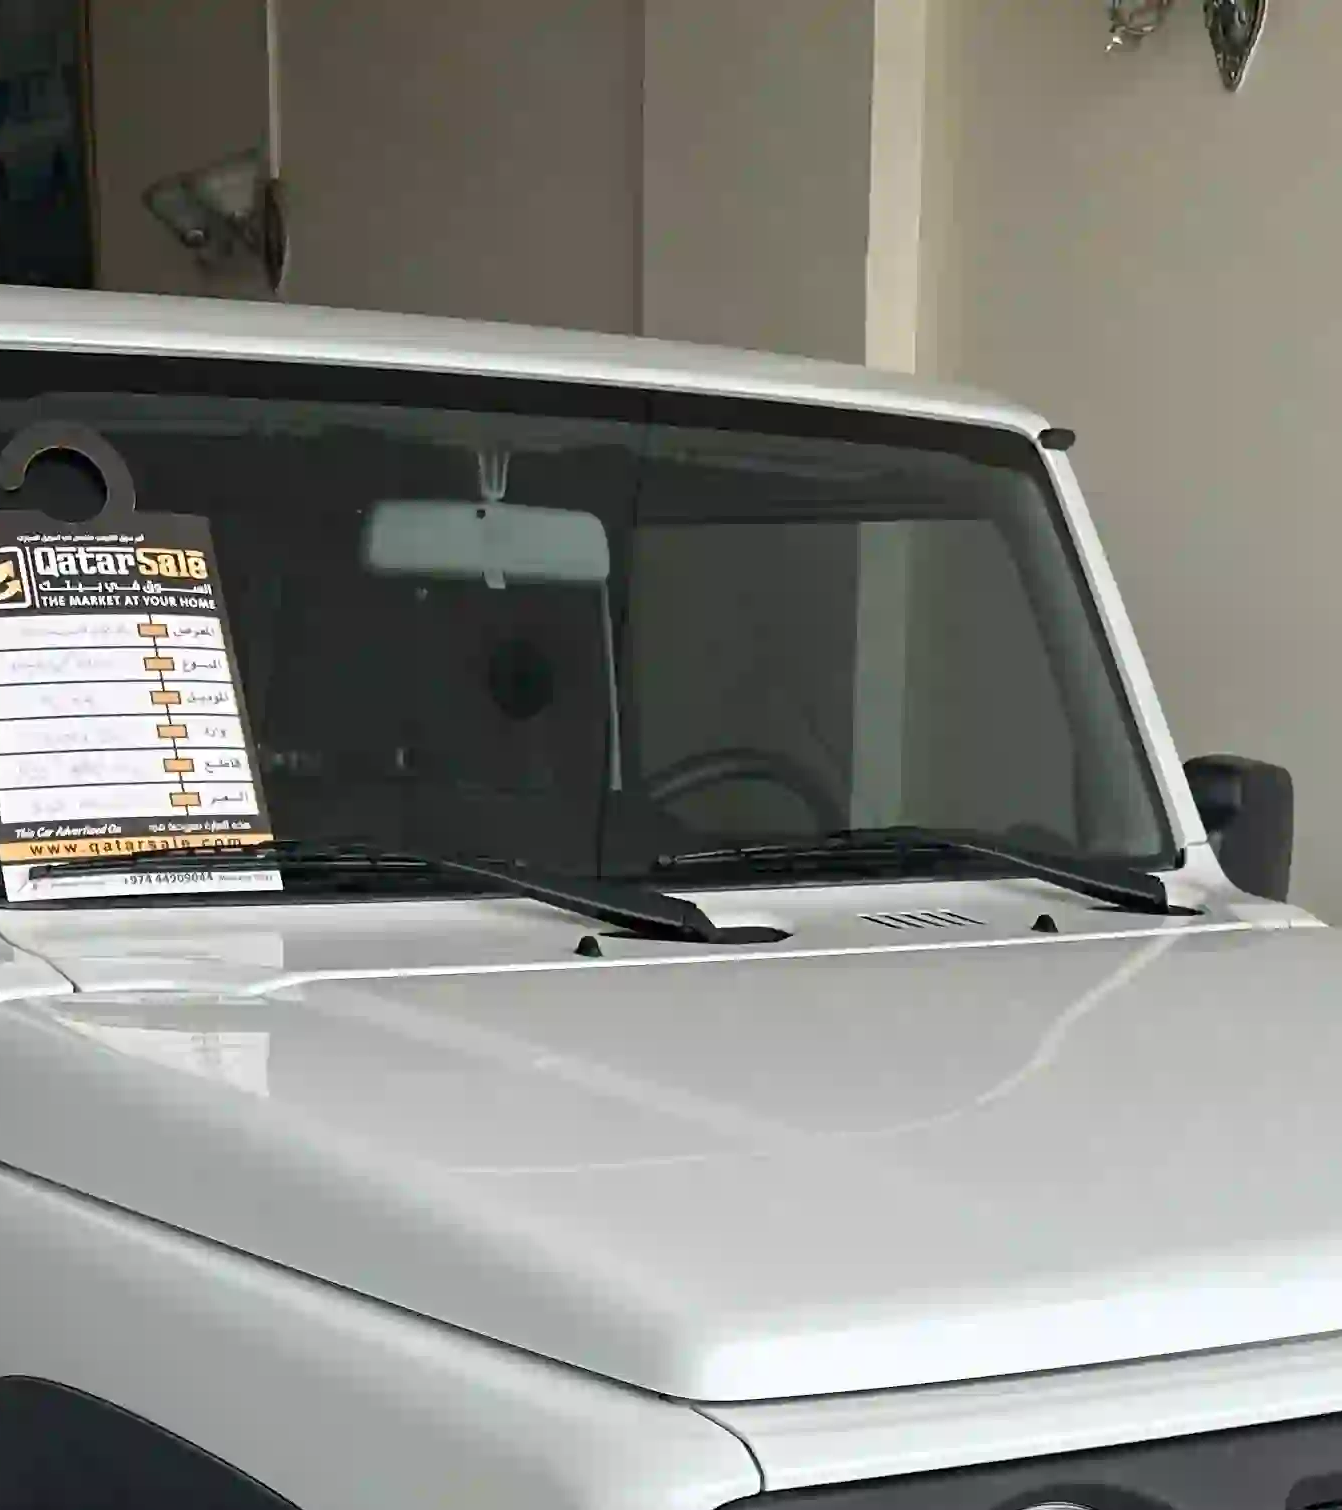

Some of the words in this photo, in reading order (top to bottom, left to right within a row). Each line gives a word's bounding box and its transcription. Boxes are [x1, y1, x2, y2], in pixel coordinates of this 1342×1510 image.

[40, 595, 66, 607] THE
[69, 595, 122, 607] MARKET
[124, 595, 140, 607] AT
[141, 595, 178, 608] YOUR
[179, 597, 217, 610] HOME
[29, 837, 241, 856] www.qatarsalecom
